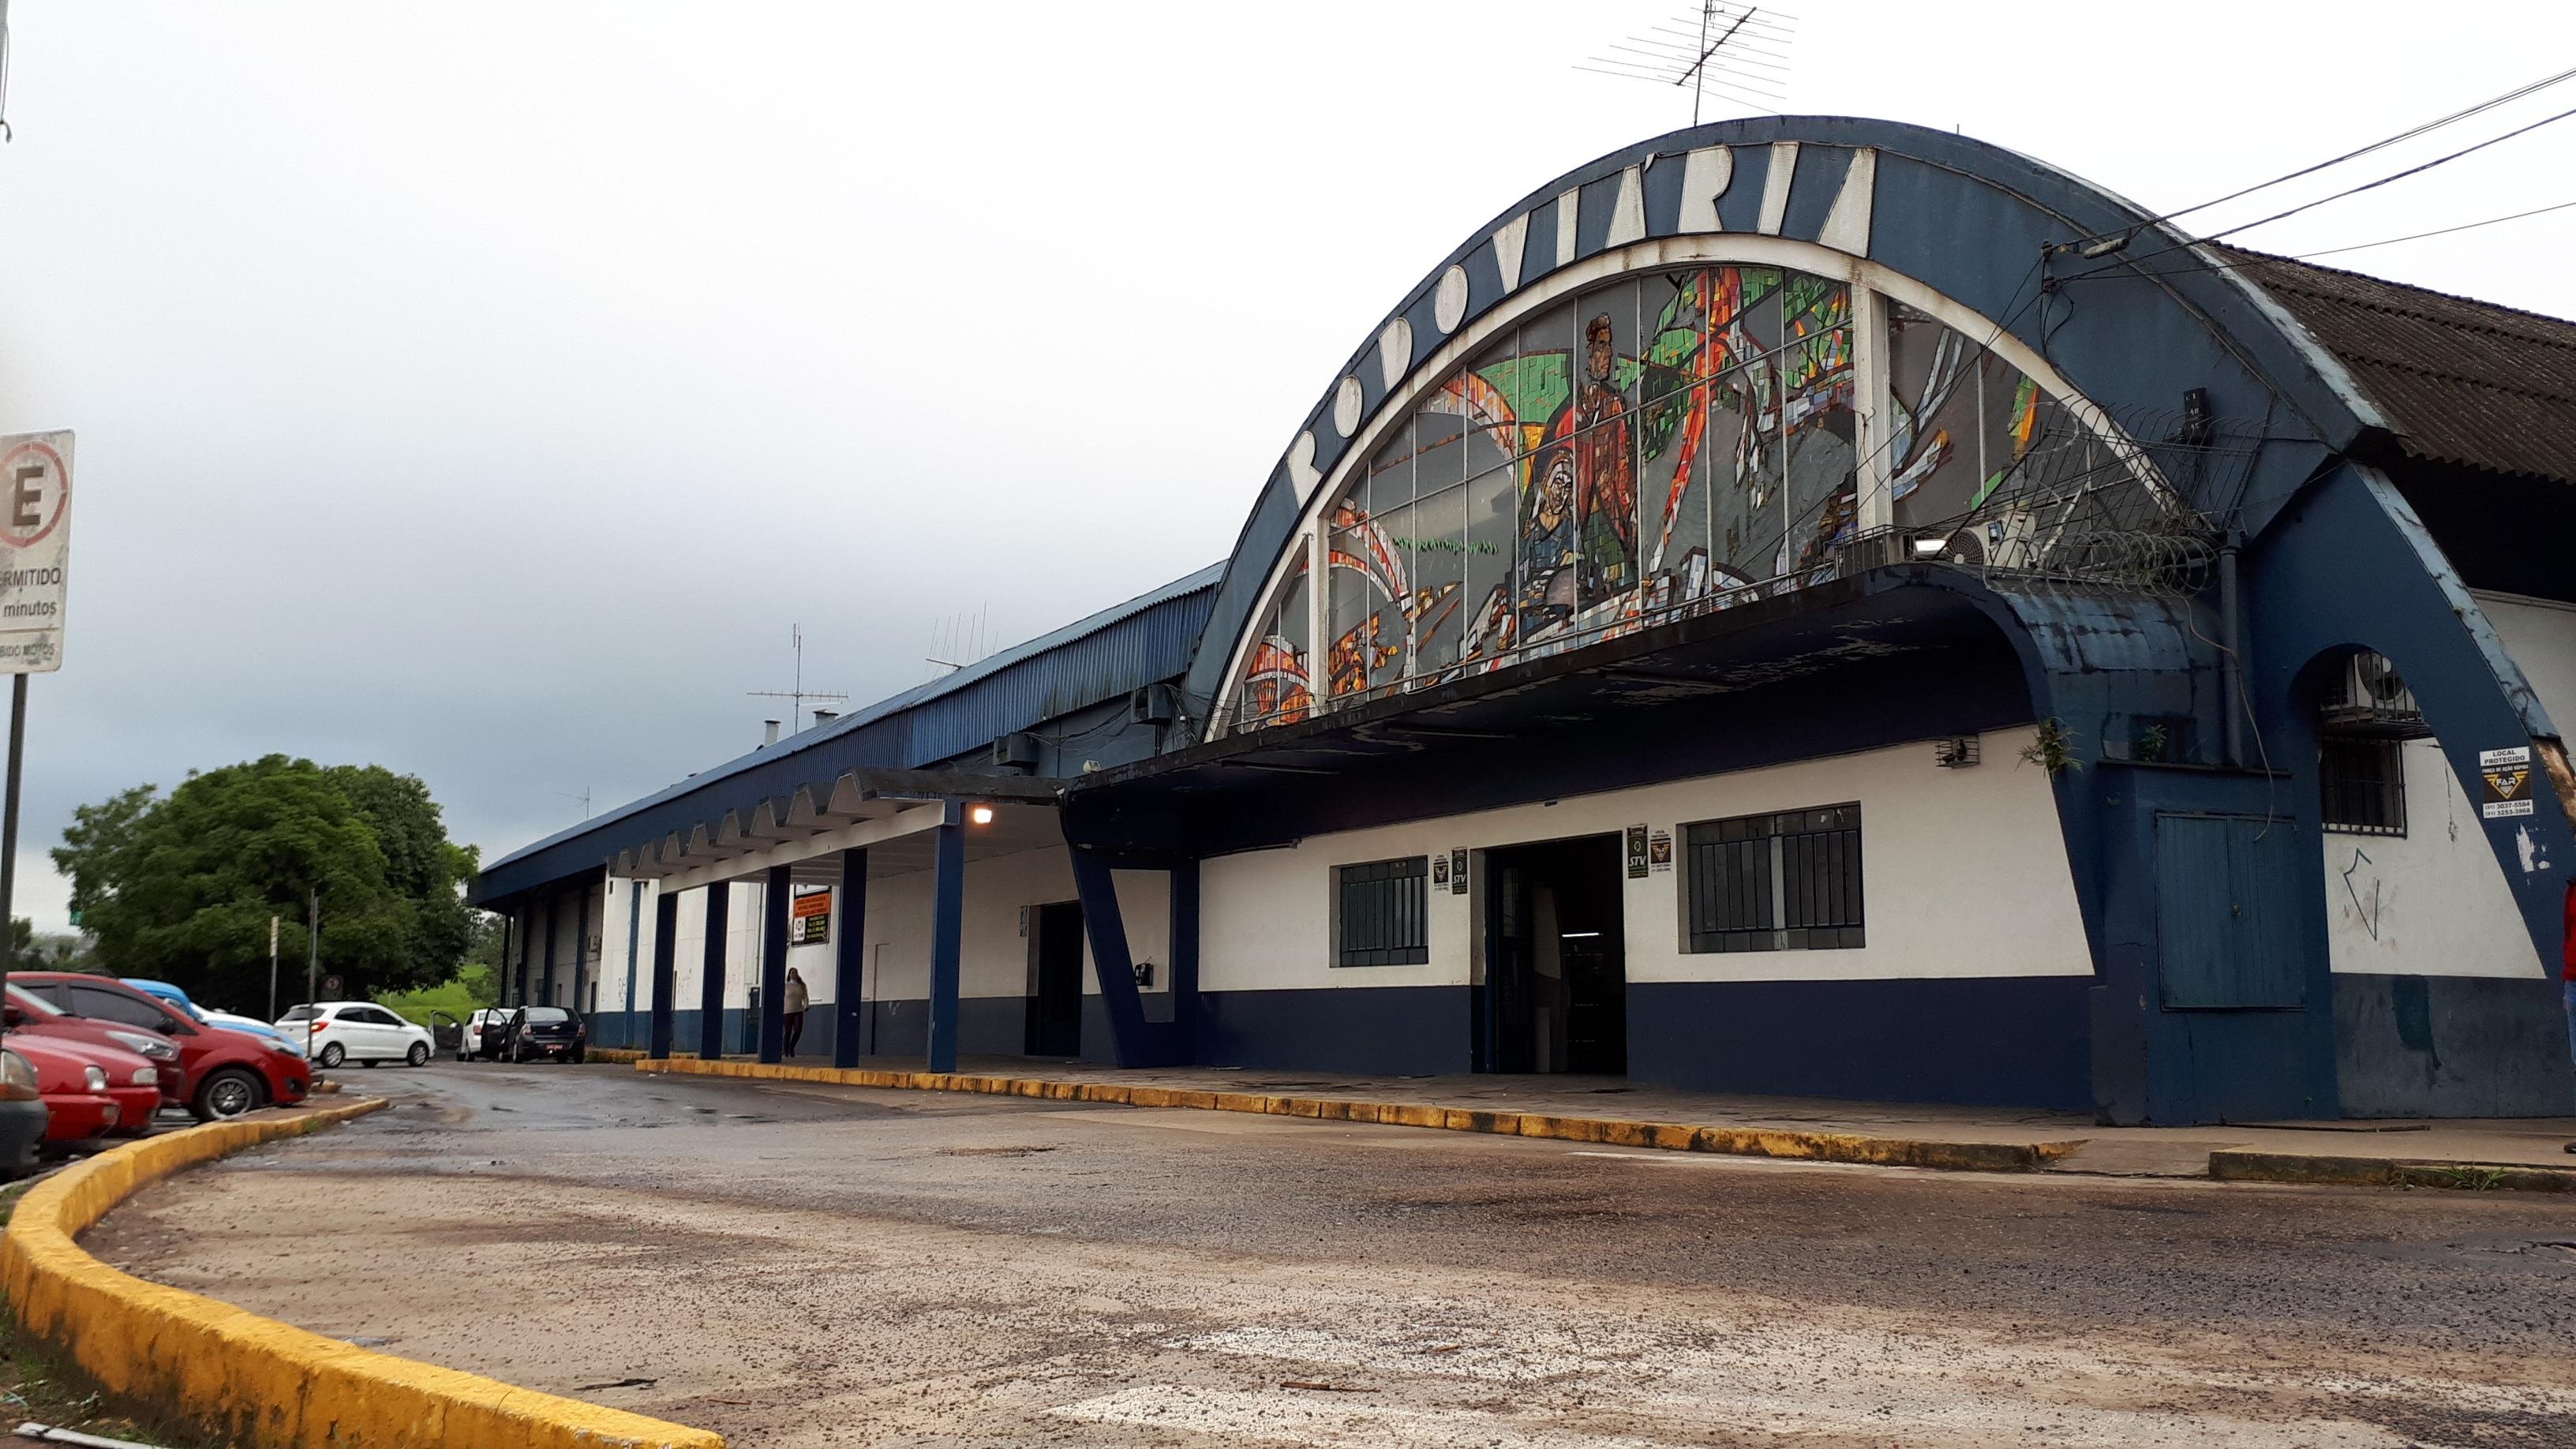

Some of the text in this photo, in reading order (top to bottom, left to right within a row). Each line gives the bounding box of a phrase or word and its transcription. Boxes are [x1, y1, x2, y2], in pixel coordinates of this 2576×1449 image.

[12, 465, 45, 526] E
[3, 601, 57, 617] minutos
[2484, 755, 2525, 764] PROTEGIDO
[2496, 777, 2516, 787] FAR
[1629, 856, 1647, 867] STV
[1452, 874, 1466, 884] STV
